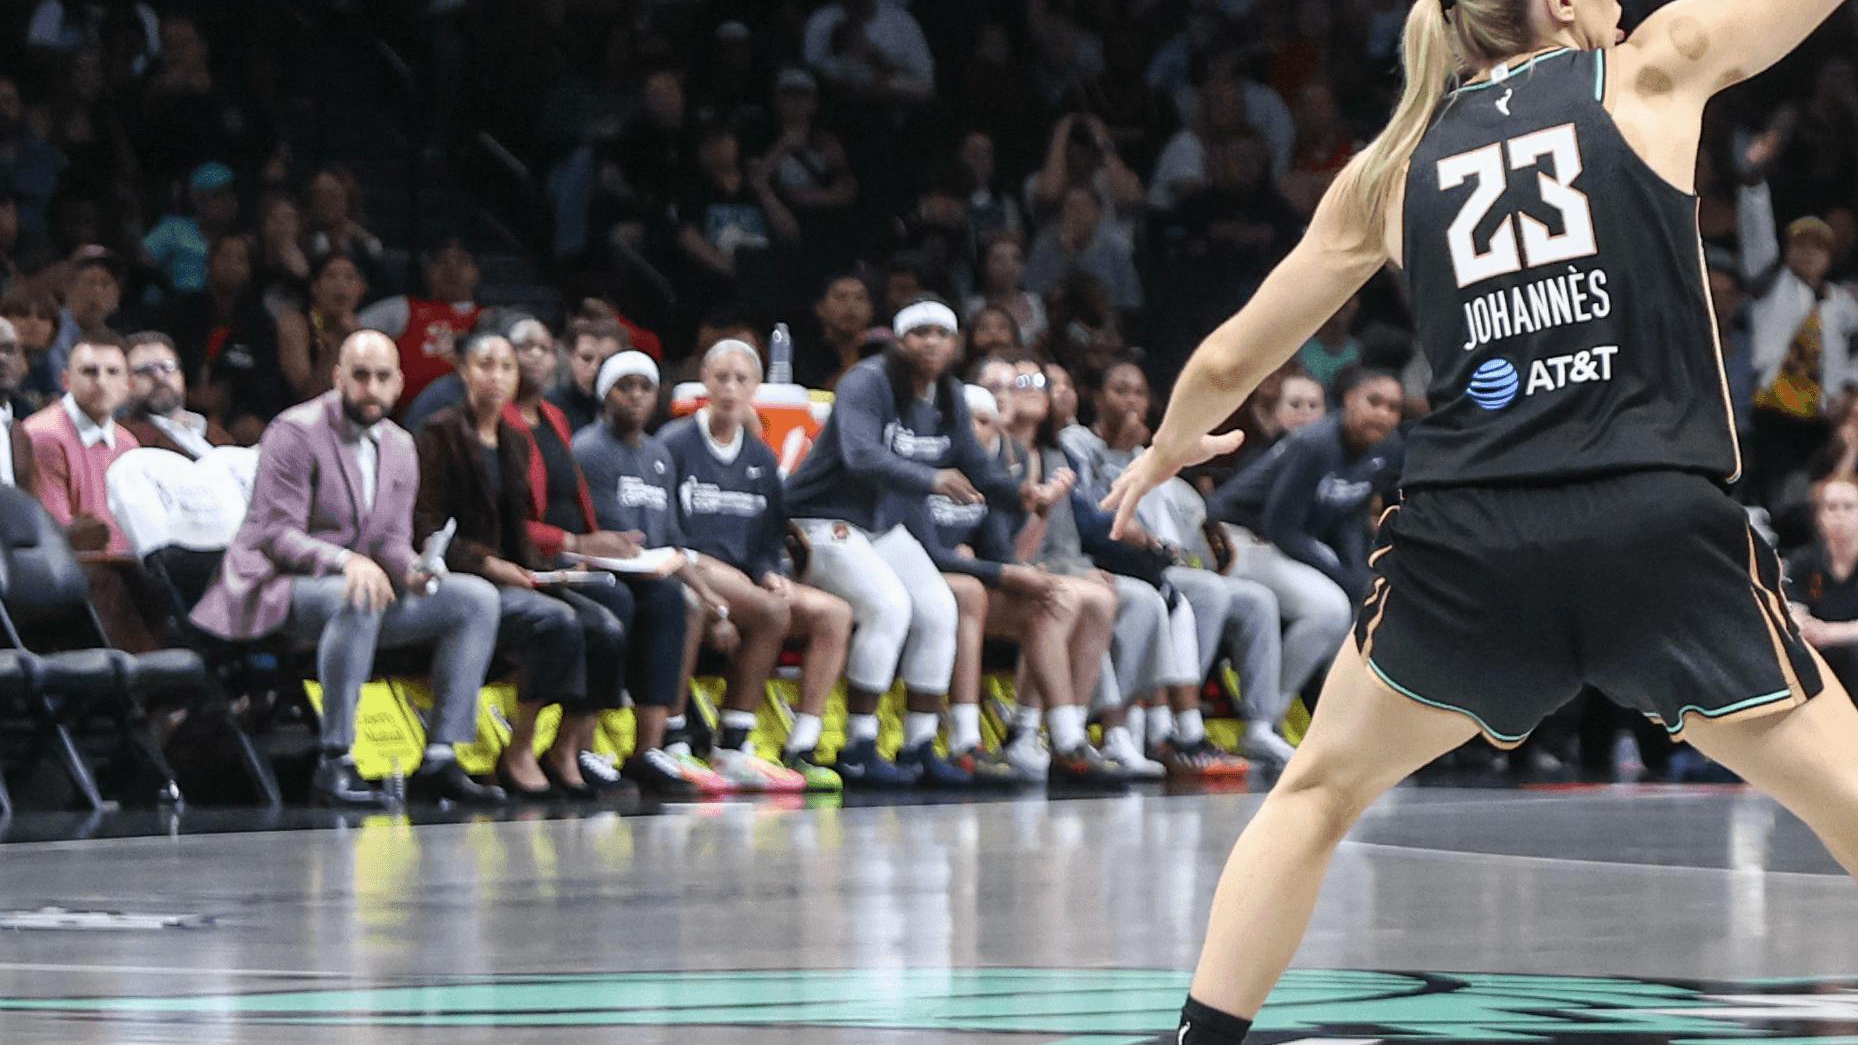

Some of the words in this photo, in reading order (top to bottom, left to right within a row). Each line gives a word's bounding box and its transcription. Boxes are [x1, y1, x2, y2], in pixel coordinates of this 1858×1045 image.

[1436, 122, 1599, 289] 23
[1462, 264, 1613, 352] JOHANNÈS
[1524, 344, 1620, 397] AT&T
